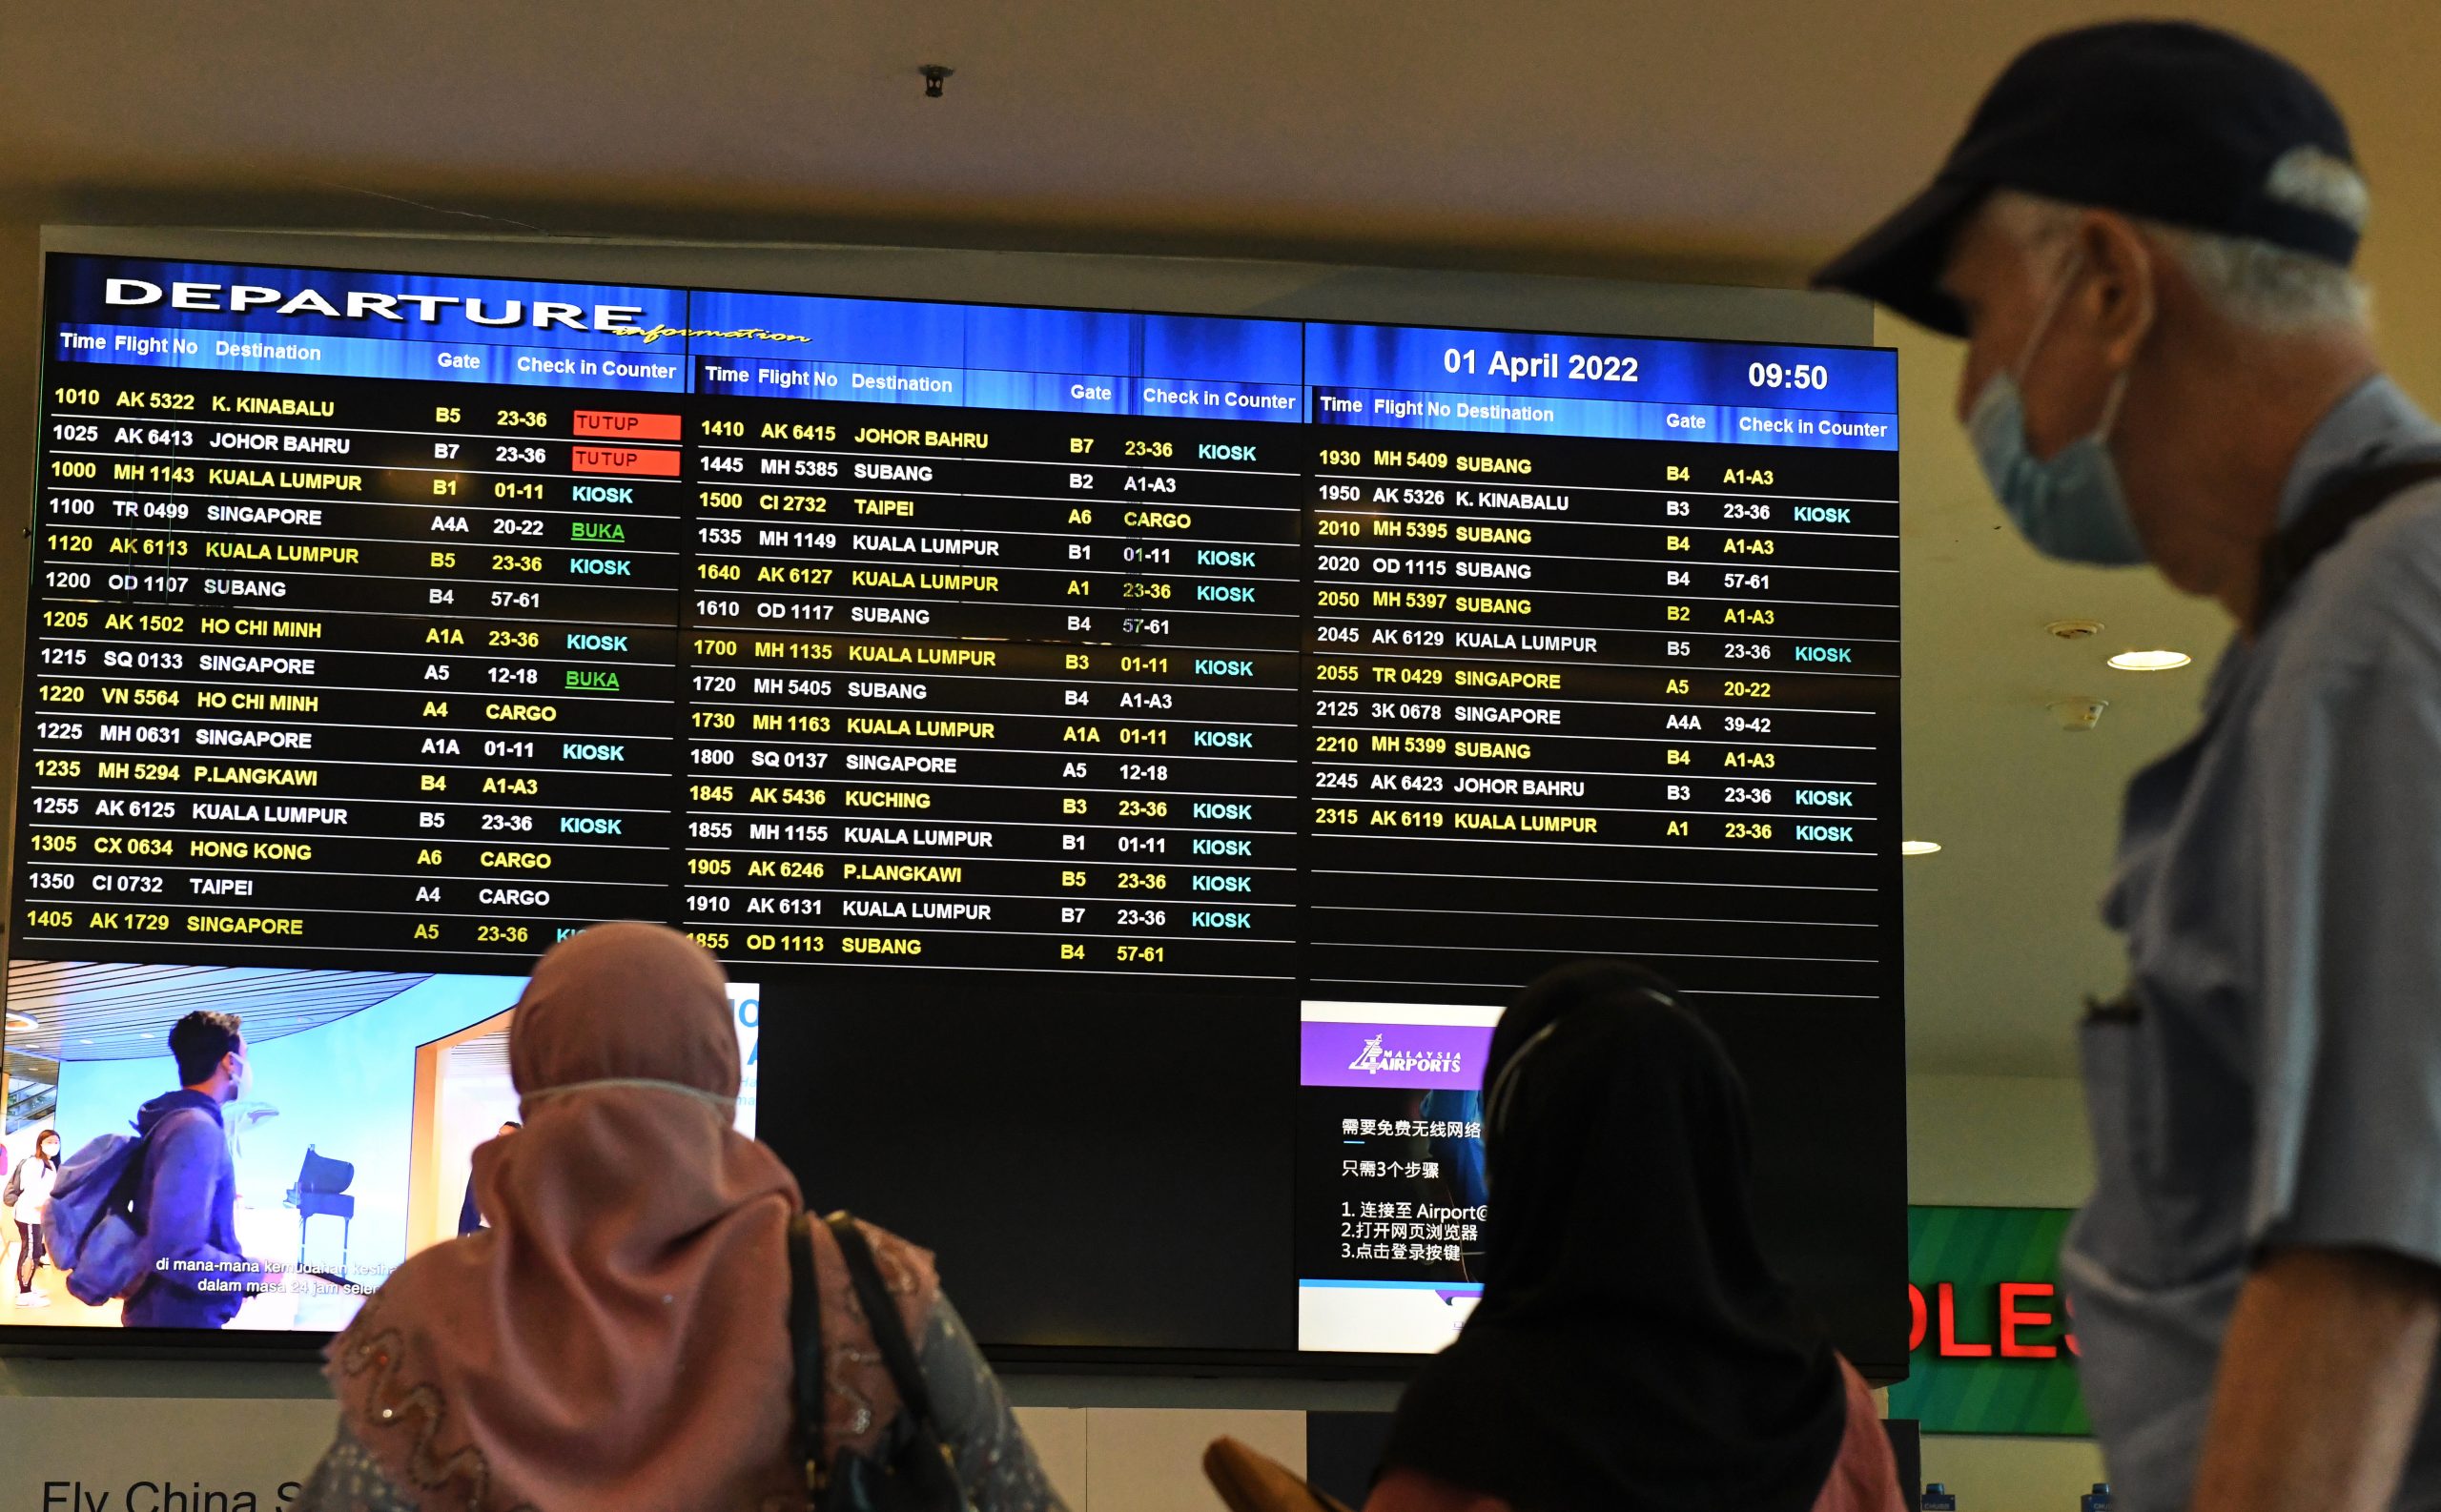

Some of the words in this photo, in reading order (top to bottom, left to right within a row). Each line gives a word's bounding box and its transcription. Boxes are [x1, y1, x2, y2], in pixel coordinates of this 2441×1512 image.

[105, 278, 643, 331] DEPARTURE
[612, 324, 811, 343] information
[60, 333, 106, 350] Time
[114, 336, 169, 356] Flight
[173, 338, 198, 355] No
[215, 341, 321, 361] Destination
[438, 353, 481, 369] Gate
[518, 357, 574, 374] Check
[580, 359, 597, 375] in
[602, 361, 676, 379] Counter
[1444, 349, 1475, 374] 01
[1487, 351, 1558, 382] April
[1569, 355, 1638, 382] 2022
[706, 366, 749, 382] Time
[758, 368, 809, 388] Flight
[814, 371, 837, 386] No
[851, 373, 952, 393] Destination
[1071, 384, 1112, 400] Gate
[1143, 388, 1199, 405] Check
[1204, 390, 1220, 406] in
[1225, 392, 1296, 410] Counter
[1749, 362, 1828, 390] 09:50
[54, 387, 100, 405] 1010
[115, 390, 145, 408] AK
[149, 392, 195, 411] 5322
[212, 396, 231, 412] K.
[236, 397, 335, 418] KINABALU
[436, 406, 462, 423] B5
[497, 410, 547, 428] 23-36
[577, 414, 639, 432] TUTUP
[1320, 396, 1363, 413] Time
[1374, 398, 1424, 419] Flight
[1428, 401, 1450, 417] No
[1457, 403, 1554, 422] Destination
[1666, 413, 1707, 429] Gate
[1739, 417, 1794, 433] Check
[1798, 419, 1814, 434] in
[1818, 420, 1888, 437] Counter
[701, 419, 745, 438] 1410
[760, 422, 789, 439] AK
[792, 424, 836, 441] 6415
[853, 427, 921, 446] JOHOR
[925, 430, 989, 449] BAHRU
[1070, 438, 1095, 454] B7
[1124, 440, 1173, 458] 23-36
[1199, 443, 1257, 461] KIOSK
[50, 497, 94, 515] 1100
[112, 500, 139, 518] TR
[143, 501, 189, 520] 0499
[207, 504, 322, 526] SINGAPORE
[430, 515, 470, 533] A4A
[493, 518, 544, 536] 20-22
[571, 521, 626, 540] BUKA
[699, 491, 743, 509] 1500
[759, 494, 779, 511] CI
[783, 495, 827, 513] 2732
[853, 499, 914, 517] TAIPEI
[1068, 508, 1092, 524] A6
[1123, 511, 1192, 529] CARGO
[1319, 484, 1361, 501] 1950
[1372, 487, 1400, 503] AK
[1403, 488, 1446, 505] 5326
[1456, 491, 1474, 507] K.
[1478, 492, 1569, 511] KINABALU
[1666, 501, 1691, 517] B3
[1723, 502, 1771, 521] 23-36
[1794, 506, 1851, 523] KIOSK
[43, 610, 89, 628] 1205
[104, 613, 134, 630] AK
[139, 615, 184, 633] 1502
[200, 617, 231, 635] HO
[235, 619, 268, 636] CHI
[273, 621, 322, 639] MINH
[425, 627, 464, 644] A1A
[488, 630, 540, 648] 23-36
[566, 633, 628, 652] KIOSK
[39, 684, 85, 703] 1220
[101, 687, 129, 705] VN
[133, 688, 180, 706] 5564
[197, 691, 227, 708] HO
[231, 693, 265, 710] CHI
[269, 694, 318, 712] MINH
[422, 701, 449, 718] A4
[485, 704, 557, 722] CARGO
[692, 675, 736, 692] 1720
[753, 678, 784, 694] MH
[788, 679, 831, 696] 5405
[848, 682, 927, 700] SUBANG
[1064, 689, 1090, 706] B4
[1119, 692, 1173, 709] A1-A3
[1316, 700, 1359, 717] 2125
[1371, 703, 1396, 719] 3K
[1399, 704, 1442, 721] 0678
[1454, 705, 1561, 725] SINGAPORE
[1666, 714, 1702, 730] A4A
[1724, 716, 1772, 733] 39-42
[689, 785, 733, 802] 1845
[749, 787, 778, 804] AK
[782, 787, 827, 806] 5436
[845, 790, 931, 809] KUCHING
[1062, 798, 1088, 814] B3
[1118, 800, 1168, 817] 23-36
[1193, 803, 1252, 821] KIOSK
[1315, 771, 1359, 789] 2245
[1370, 774, 1398, 790] AK
[1401, 775, 1444, 792] 6423
[1453, 777, 1519, 795] JOHOR
[1522, 779, 1585, 797] BAHRU
[1667, 785, 1691, 801] B3
[1724, 787, 1772, 804] 23-36
[1795, 789, 1854, 807] KIOSK
[31, 834, 77, 852] 1305
[93, 836, 123, 854] CX
[127, 838, 174, 856] 0634
[190, 840, 249, 859] HONG
[253, 843, 312, 861] KONG
[417, 848, 442, 866] A6
[480, 850, 552, 869] CARGO
[687, 858, 731, 875] 1905
[748, 860, 776, 877] AK
[780, 861, 825, 879] 6246
[843, 863, 962, 883] P.LANGKAWI
[1061, 870, 1087, 888] B5
[1118, 872, 1167, 889] 23-36
[1192, 875, 1252, 892] KIOSK
[1378, 1058, 1462, 1073] AIRPORTS
[1384, 1050, 1462, 1060] MALAYSIA
[1342, 1118, 1482, 1138] 需要免费无线网络
[1342, 1159, 1440, 1179] 只需3个步骤
[1341, 1201, 1355, 1217] 1.
[1360, 1201, 1413, 1219] 连接至
[1341, 1221, 1478, 1241] 2.打开网页浏览器
[155, 1257, 169, 1272] di
[173, 1259, 260, 1274] mana-mana
[1341, 1242, 1461, 1261] 3.点击登录按键
[197, 1278, 242, 1292] dalam
[246, 1281, 286, 1293] masa
[290, 1281, 311, 1294] 24
[312, 1281, 339, 1296] jam
[126, 1481, 256, 1512] China
